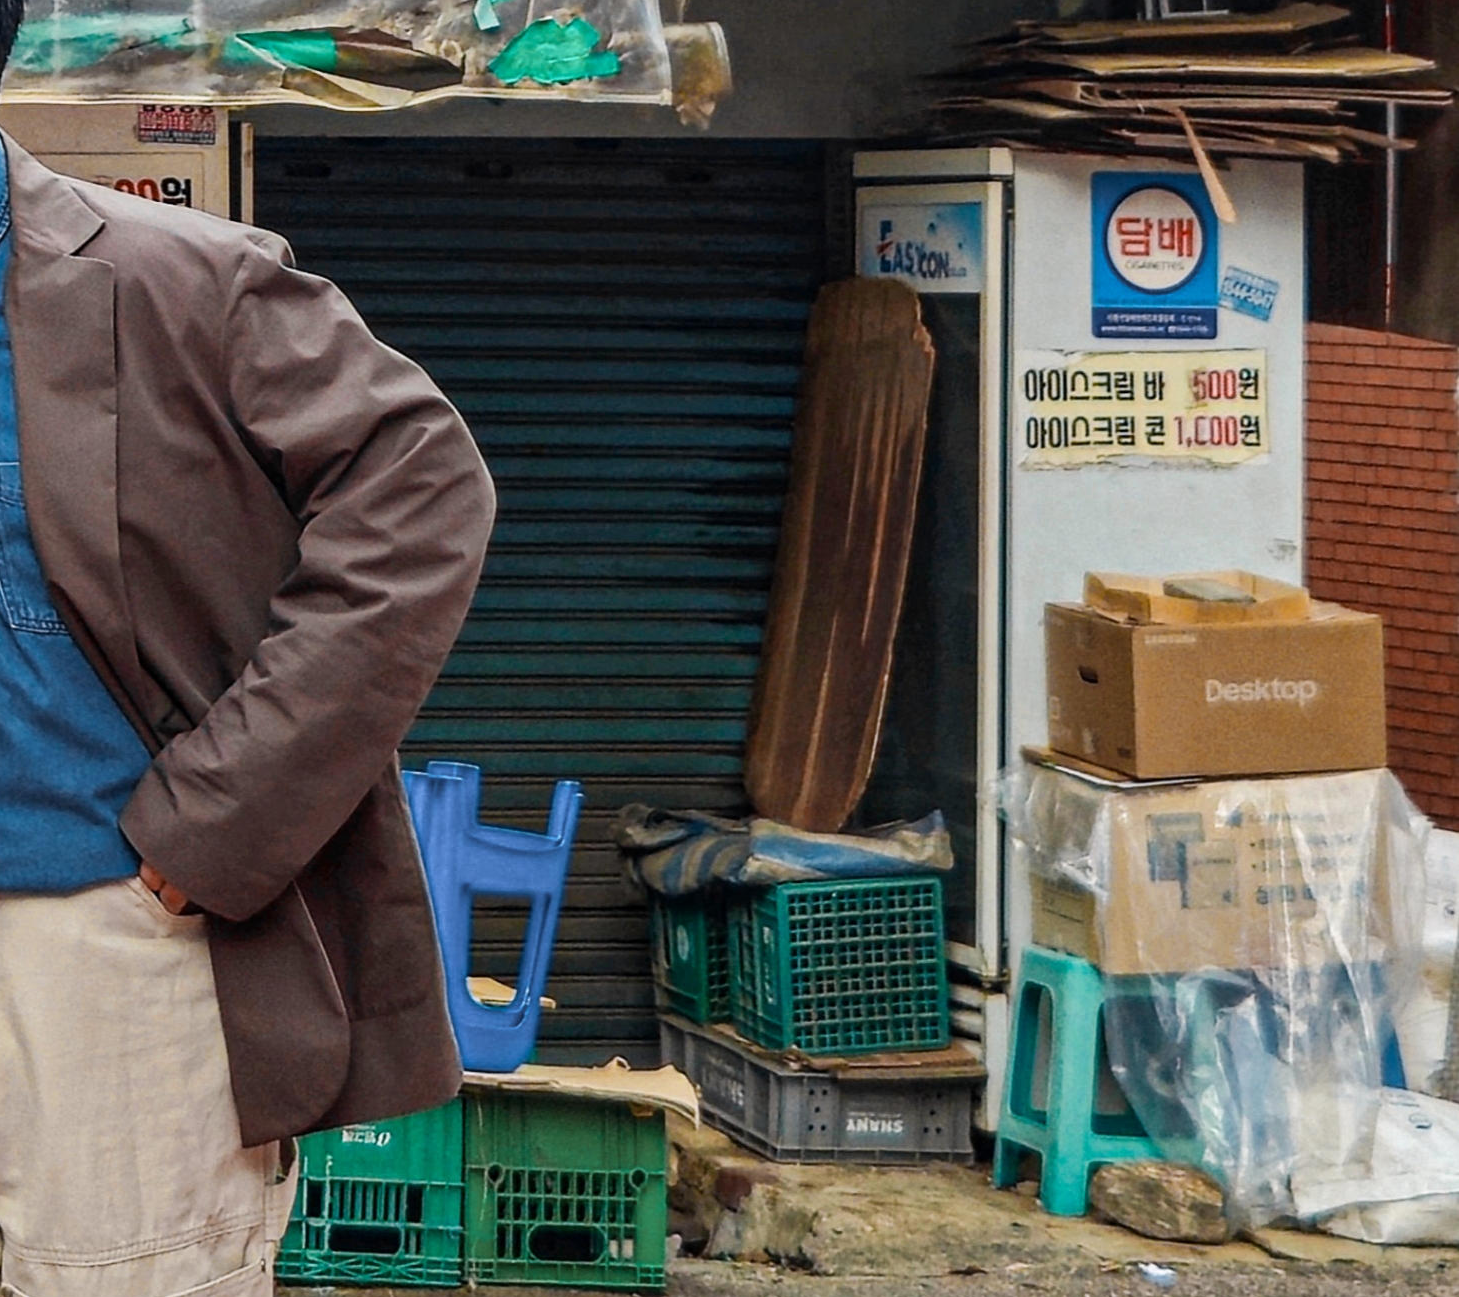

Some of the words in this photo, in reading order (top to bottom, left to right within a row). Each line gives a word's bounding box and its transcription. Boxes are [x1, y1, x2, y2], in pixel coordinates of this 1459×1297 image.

[1115, 217, 1195, 258] 담배
[1024, 368, 1135, 401] 아이스크림
[1144, 370, 1165, 401] 바
[1190, 367, 1259, 401] 500원
[1026, 416, 1136, 449] 아이스크림
[1144, 415, 1166, 447] 콘
[1205, 677, 1318, 708] Desktop
